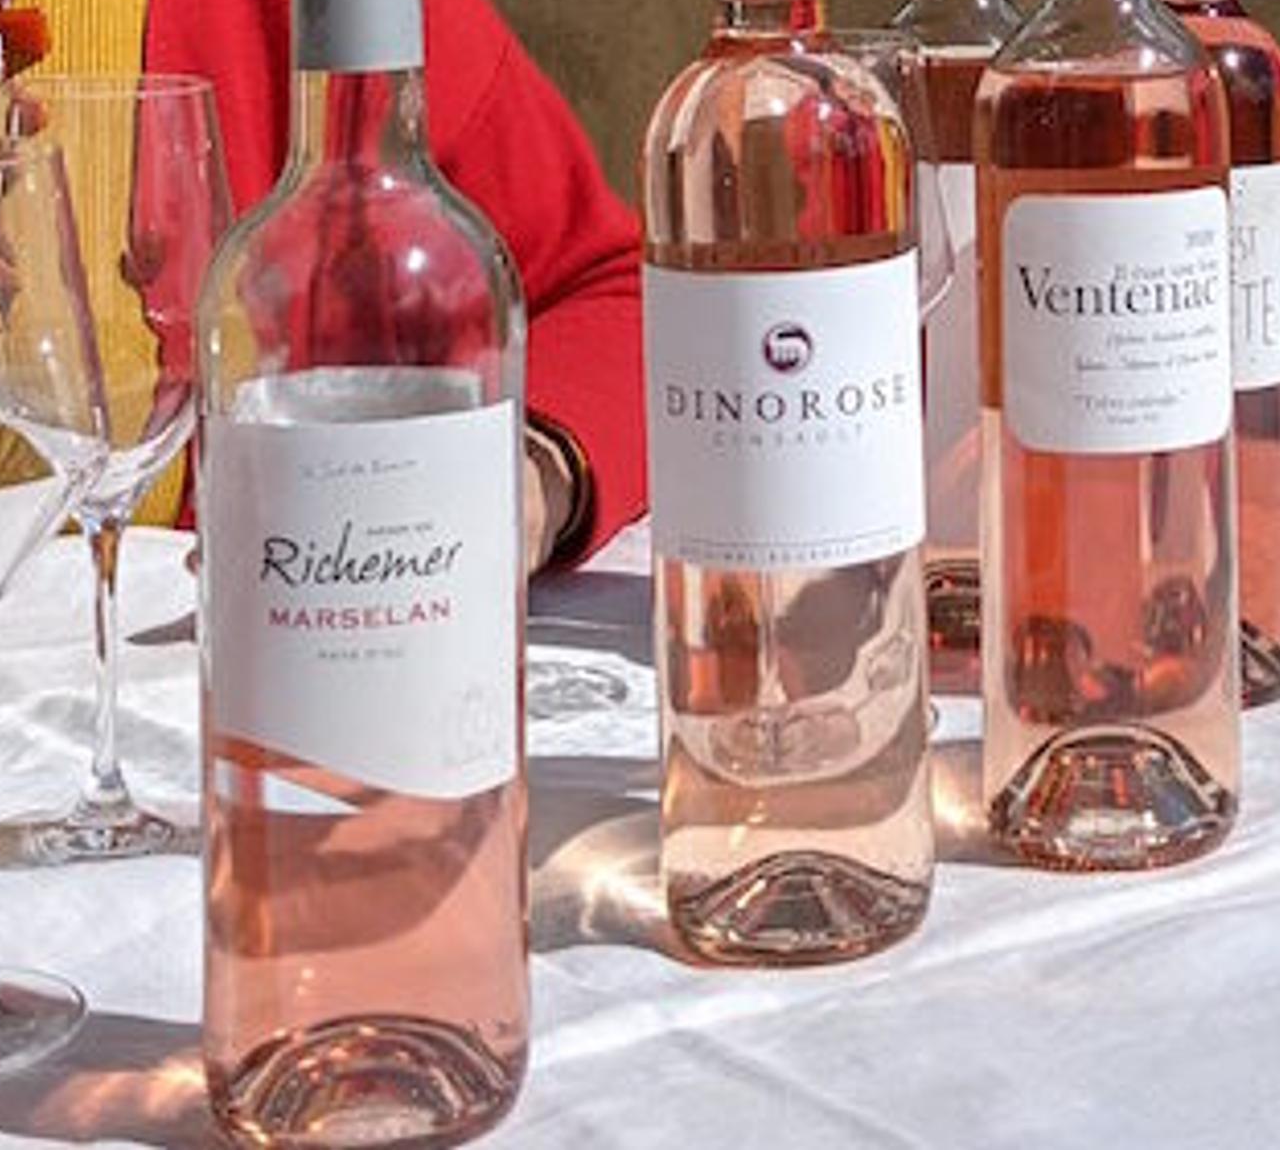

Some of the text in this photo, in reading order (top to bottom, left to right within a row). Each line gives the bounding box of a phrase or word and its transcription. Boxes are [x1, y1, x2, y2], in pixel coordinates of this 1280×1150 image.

[1018, 264, 1219, 317] Ventenac
[664, 372, 907, 425] DINOROSE
[260, 520, 464, 588] Richemer
[267, 596, 452, 632] MARSELAN
